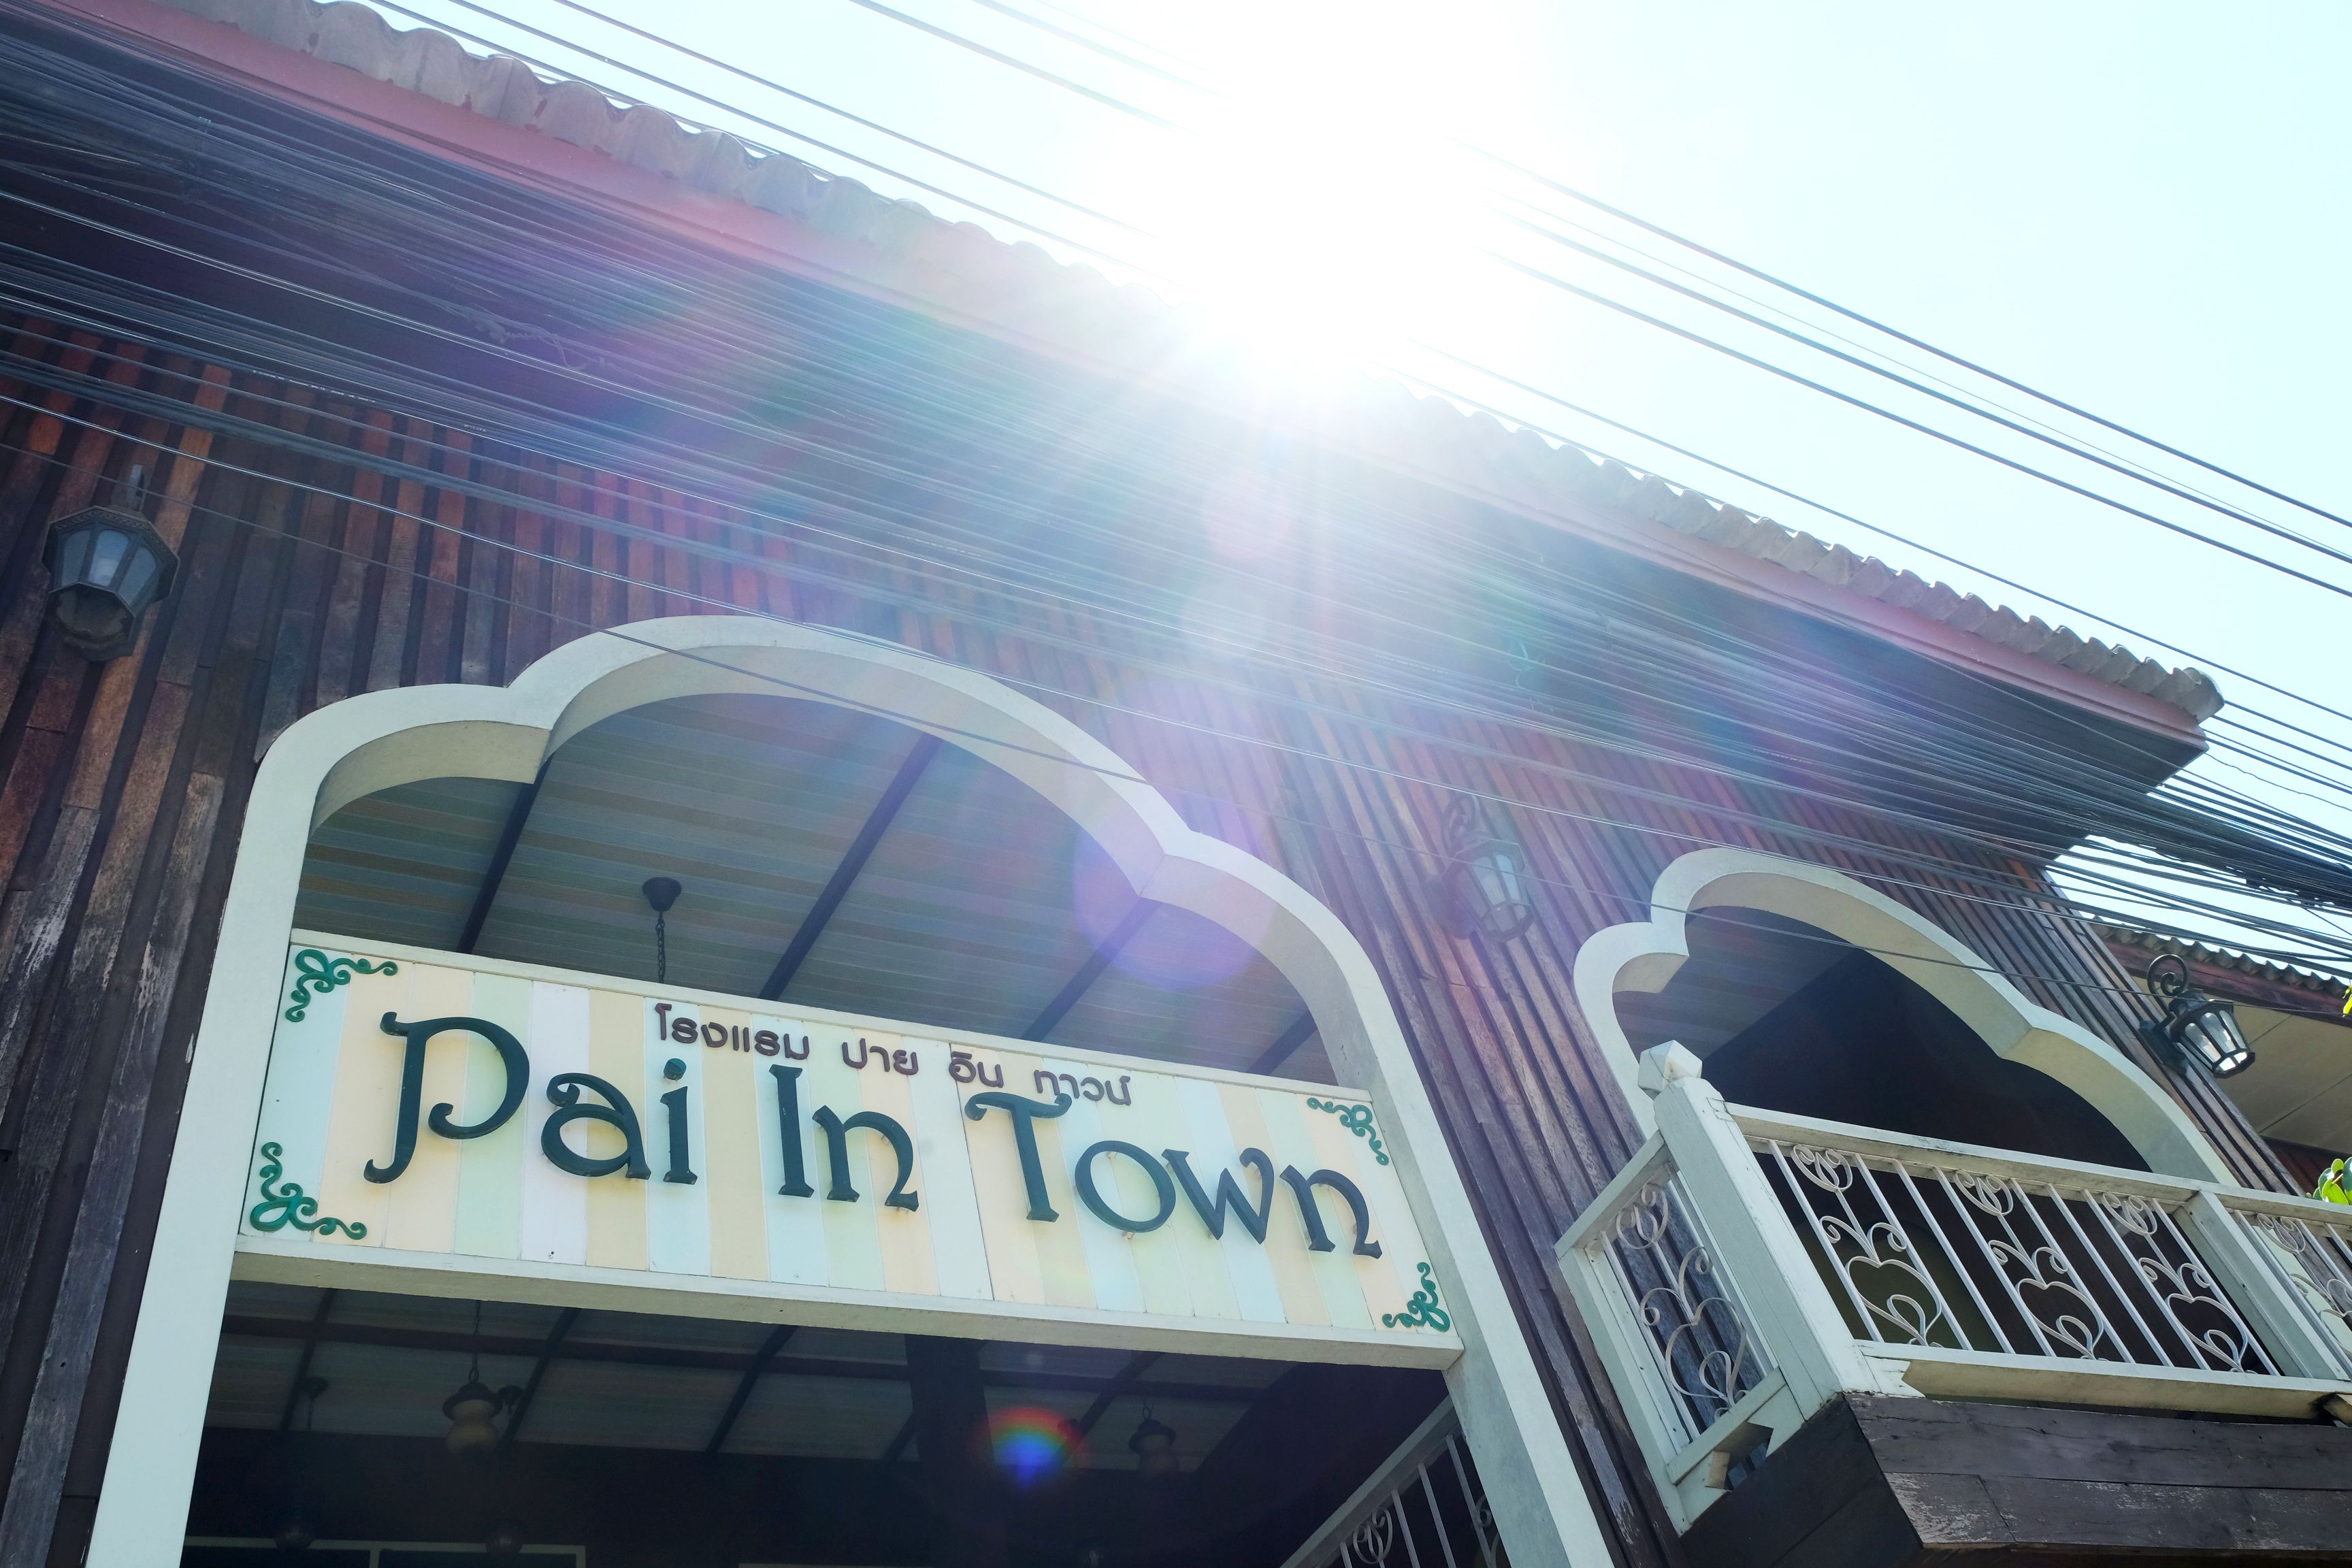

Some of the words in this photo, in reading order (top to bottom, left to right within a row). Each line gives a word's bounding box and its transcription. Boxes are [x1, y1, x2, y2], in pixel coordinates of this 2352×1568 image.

[363, 1012, 698, 1186] Pai
[769, 1064, 919, 1213] In
[964, 1091, 1383, 1260] Town
[655, 1002, 810, 1060] โรงแรม
[841, 1038, 919, 1076] ปาย
[949, 1051, 1004, 1088] อิน
[1034, 1069, 1132, 1107] ทาวน์
